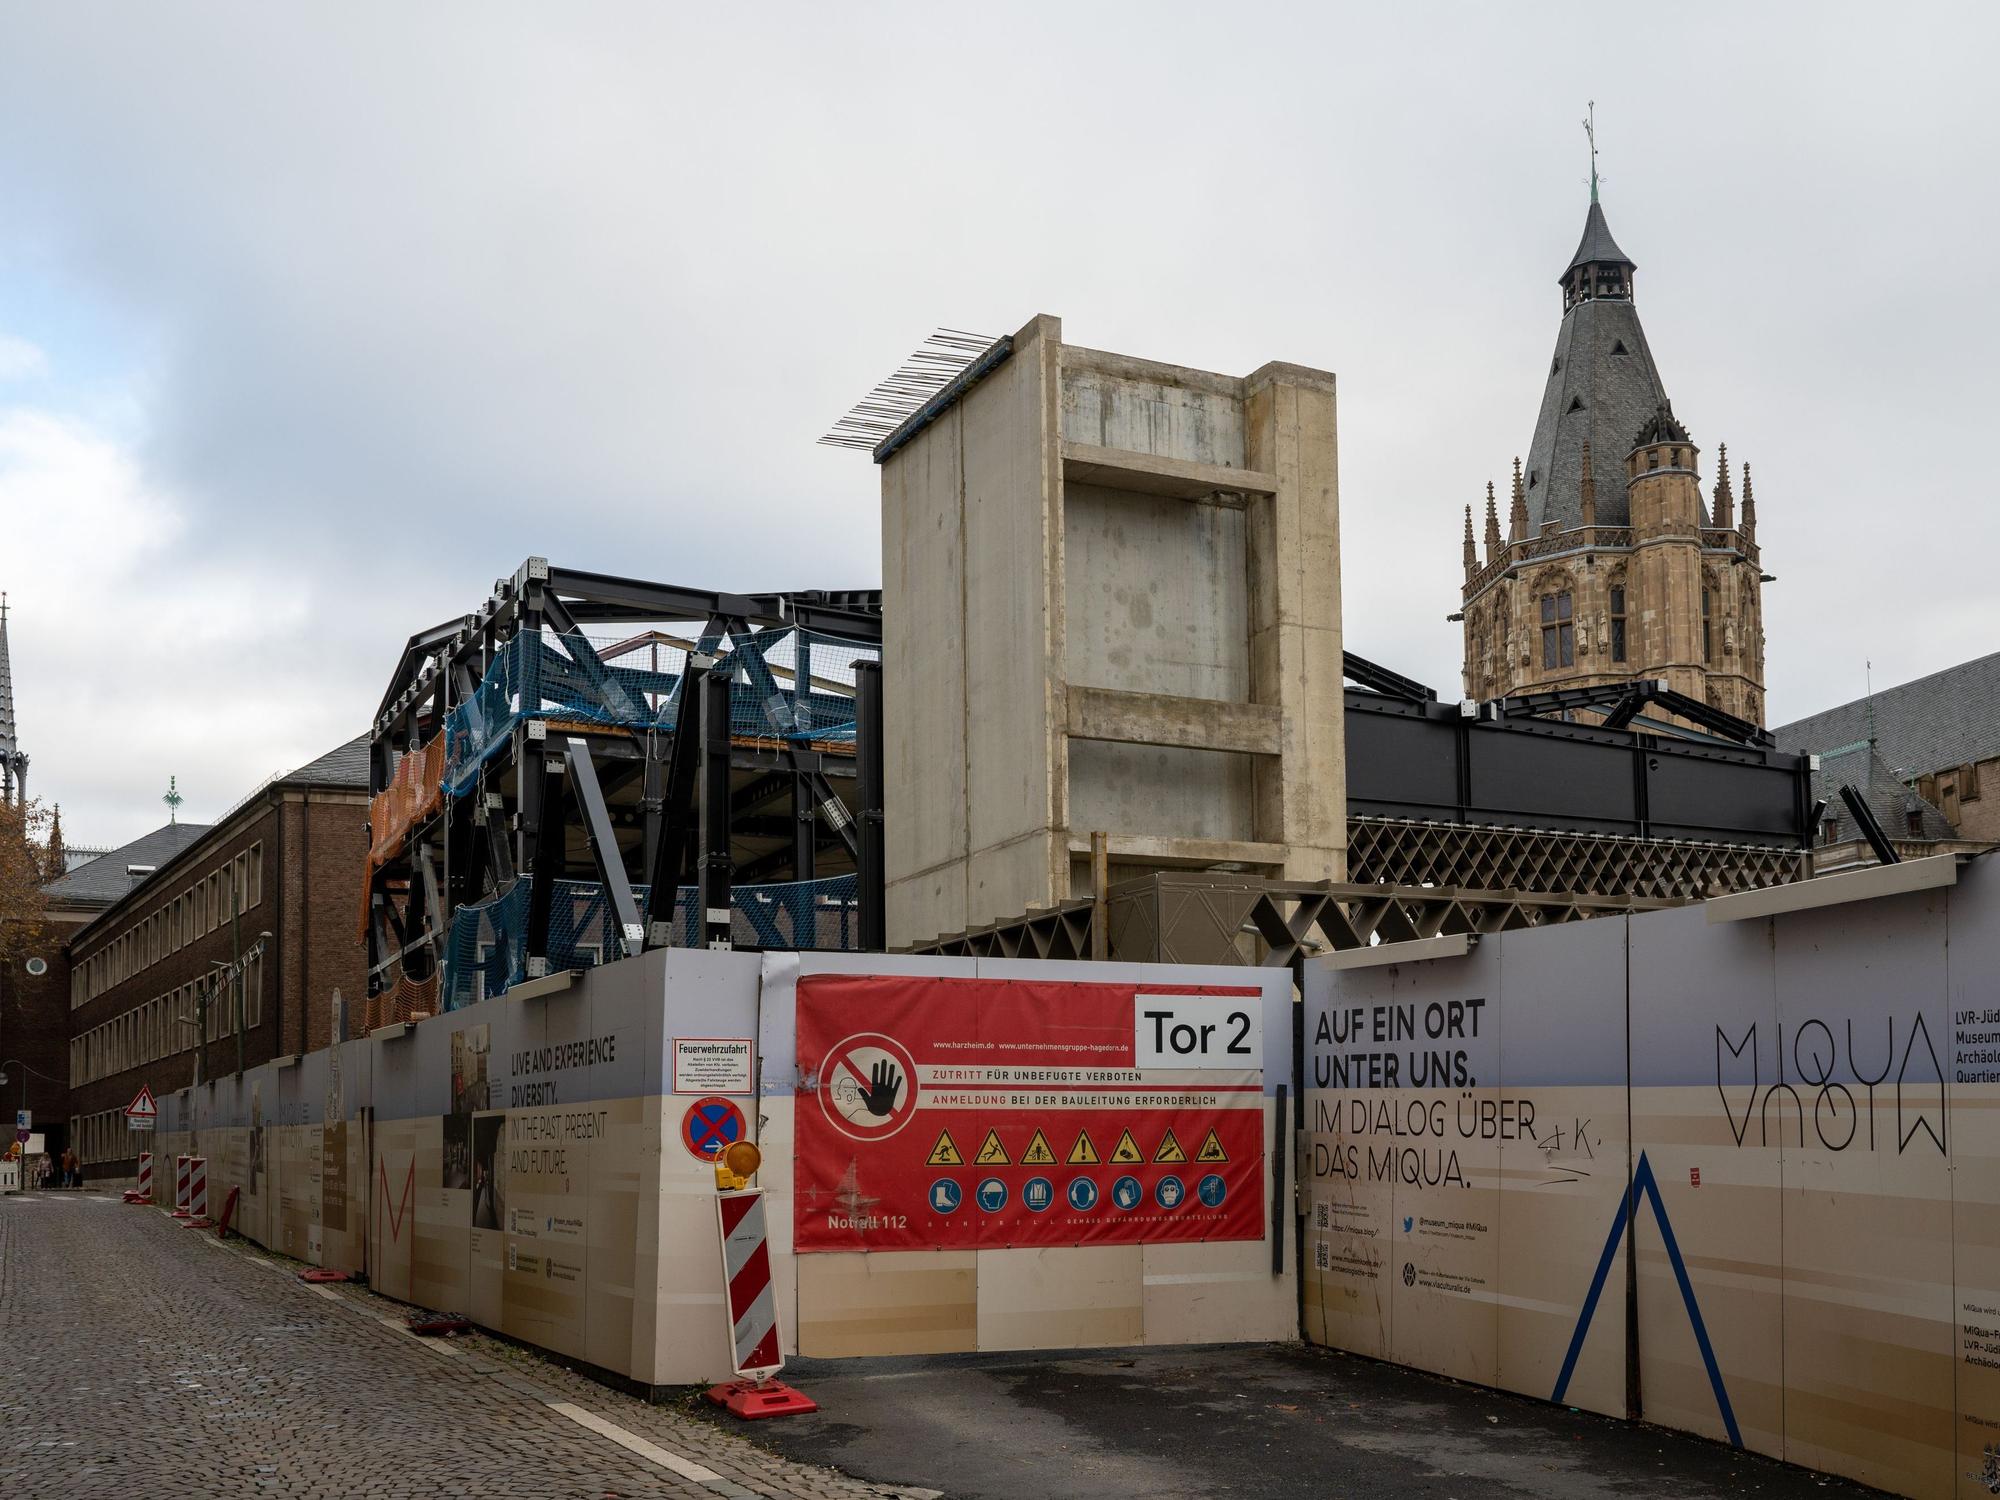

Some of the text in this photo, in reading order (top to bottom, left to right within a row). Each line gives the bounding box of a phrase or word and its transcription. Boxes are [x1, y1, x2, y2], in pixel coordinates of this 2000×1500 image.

[1144, 1011, 1252, 1055] Tor 2
[1315, 998, 1485, 1045] AUF EIN ORT
[511, 1035, 615, 1076] LIVE AND EXPERIENCE
[679, 1043, 747, 1054] Feuerwehrzufahrt
[933, 1041, 1129, 1053] www.harzheim.de www.unternehmensgruppe-hagedorn.de
[1716, 1011, 1945, 1086] MIQUA
[933, 1069, 1142, 1081] ZUTRITT FÜR UNBEFUGTE VERBOTEN
[1314, 1050, 1477, 1089] UNTER UNS.
[511, 1081, 558, 1108] DIVERSITY.
[933, 1096, 1216, 1105] ANMELDUNG BEI DER BAULEITUNG ERFORDERLICH
[512, 1116, 520, 1140] IN
[521, 1116, 538, 1140] THE
[565, 1111, 607, 1139] PRESENT
[1315, 1092, 1537, 1140] IM DIALOG ÜBER
[511, 1149, 568, 1175] AND FUTURE.
[1315, 1143, 1471, 1190] DAS MIQUA.
[882, 1215, 908, 1229] 112
[1963, 1304, 1983, 1313] MiQua
[1984, 1306, 1996, 1316] wird
